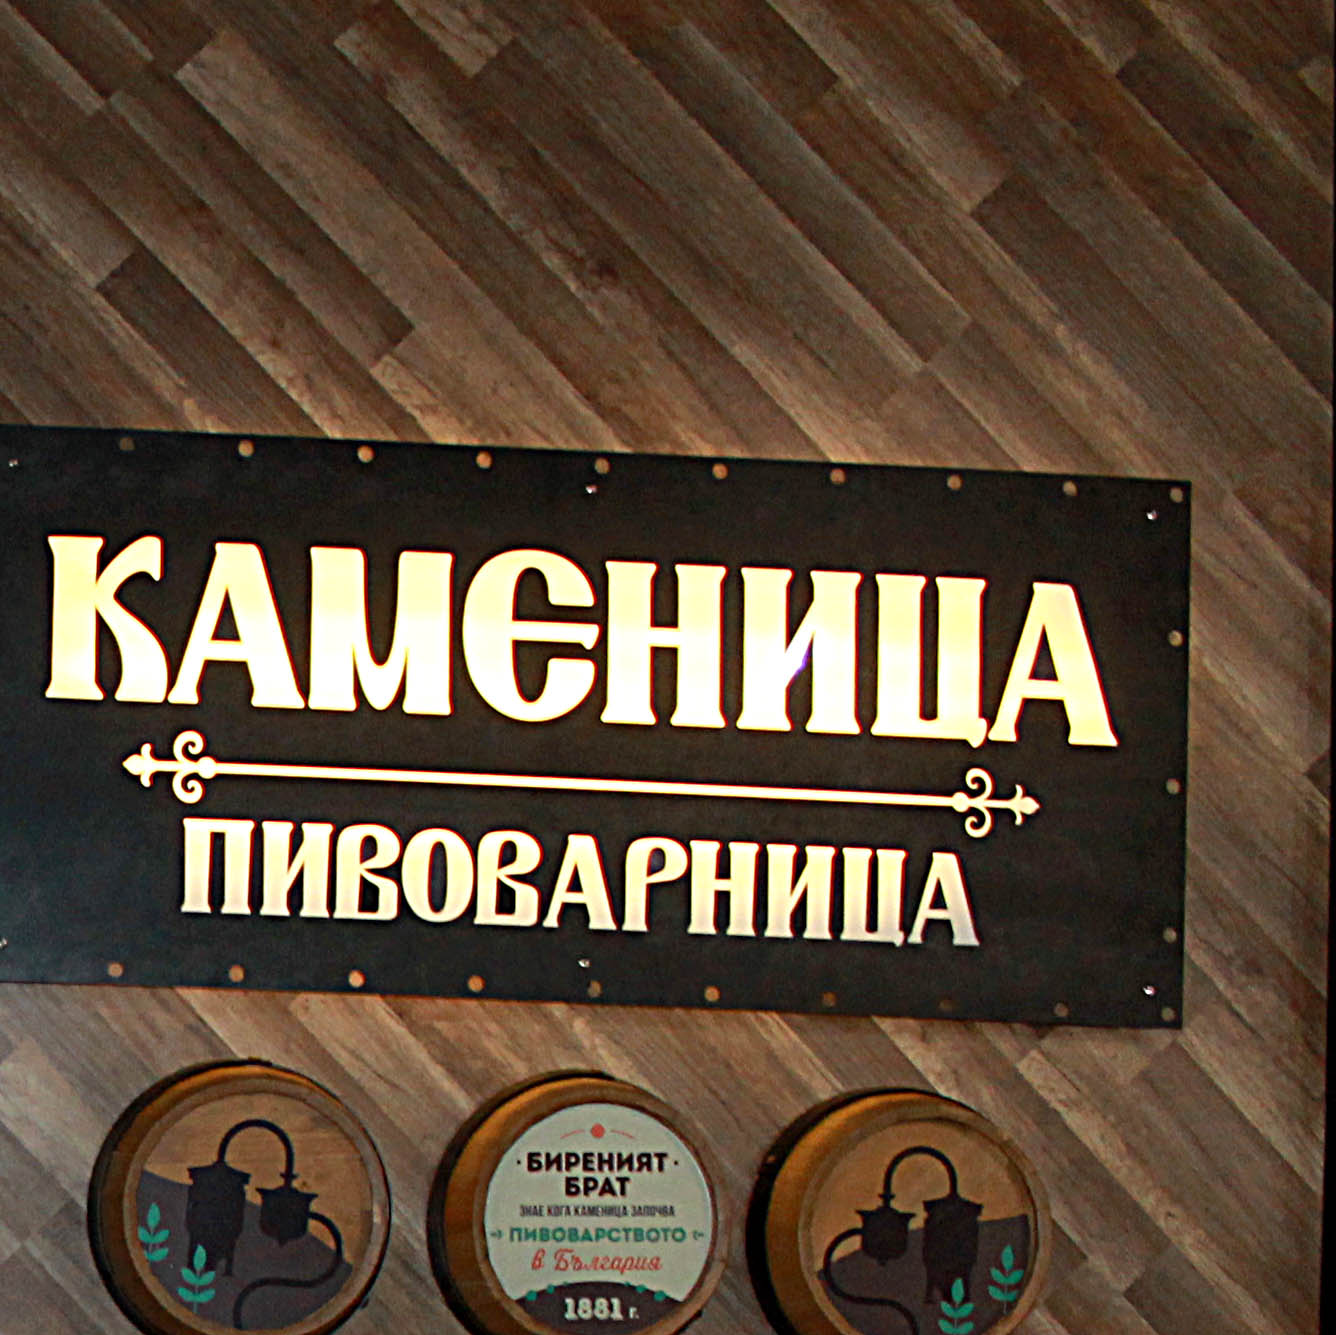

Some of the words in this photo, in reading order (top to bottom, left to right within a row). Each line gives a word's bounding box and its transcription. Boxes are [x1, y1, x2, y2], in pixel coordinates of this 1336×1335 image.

[180, 815, 980, 947] ПИВОВАРНИЦА
[527, 1151, 668, 1173] БИРЕНИЯТ
[564, 1176, 631, 1197] БРАТ
[519, 1204, 545, 1218] ЗНАЕ
[546, 1204, 572, 1218] КОГА
[573, 1204, 629, 1219] КАМЕНИЦА
[630, 1204, 676, 1218] ЗАПОЧВА
[509, 1226, 688, 1243] ПИВОВАРСТВОТО
[530, 1247, 547, 1271] в
[554, 1247, 664, 1275] България
[564, 1297, 624, 1321] 1881
